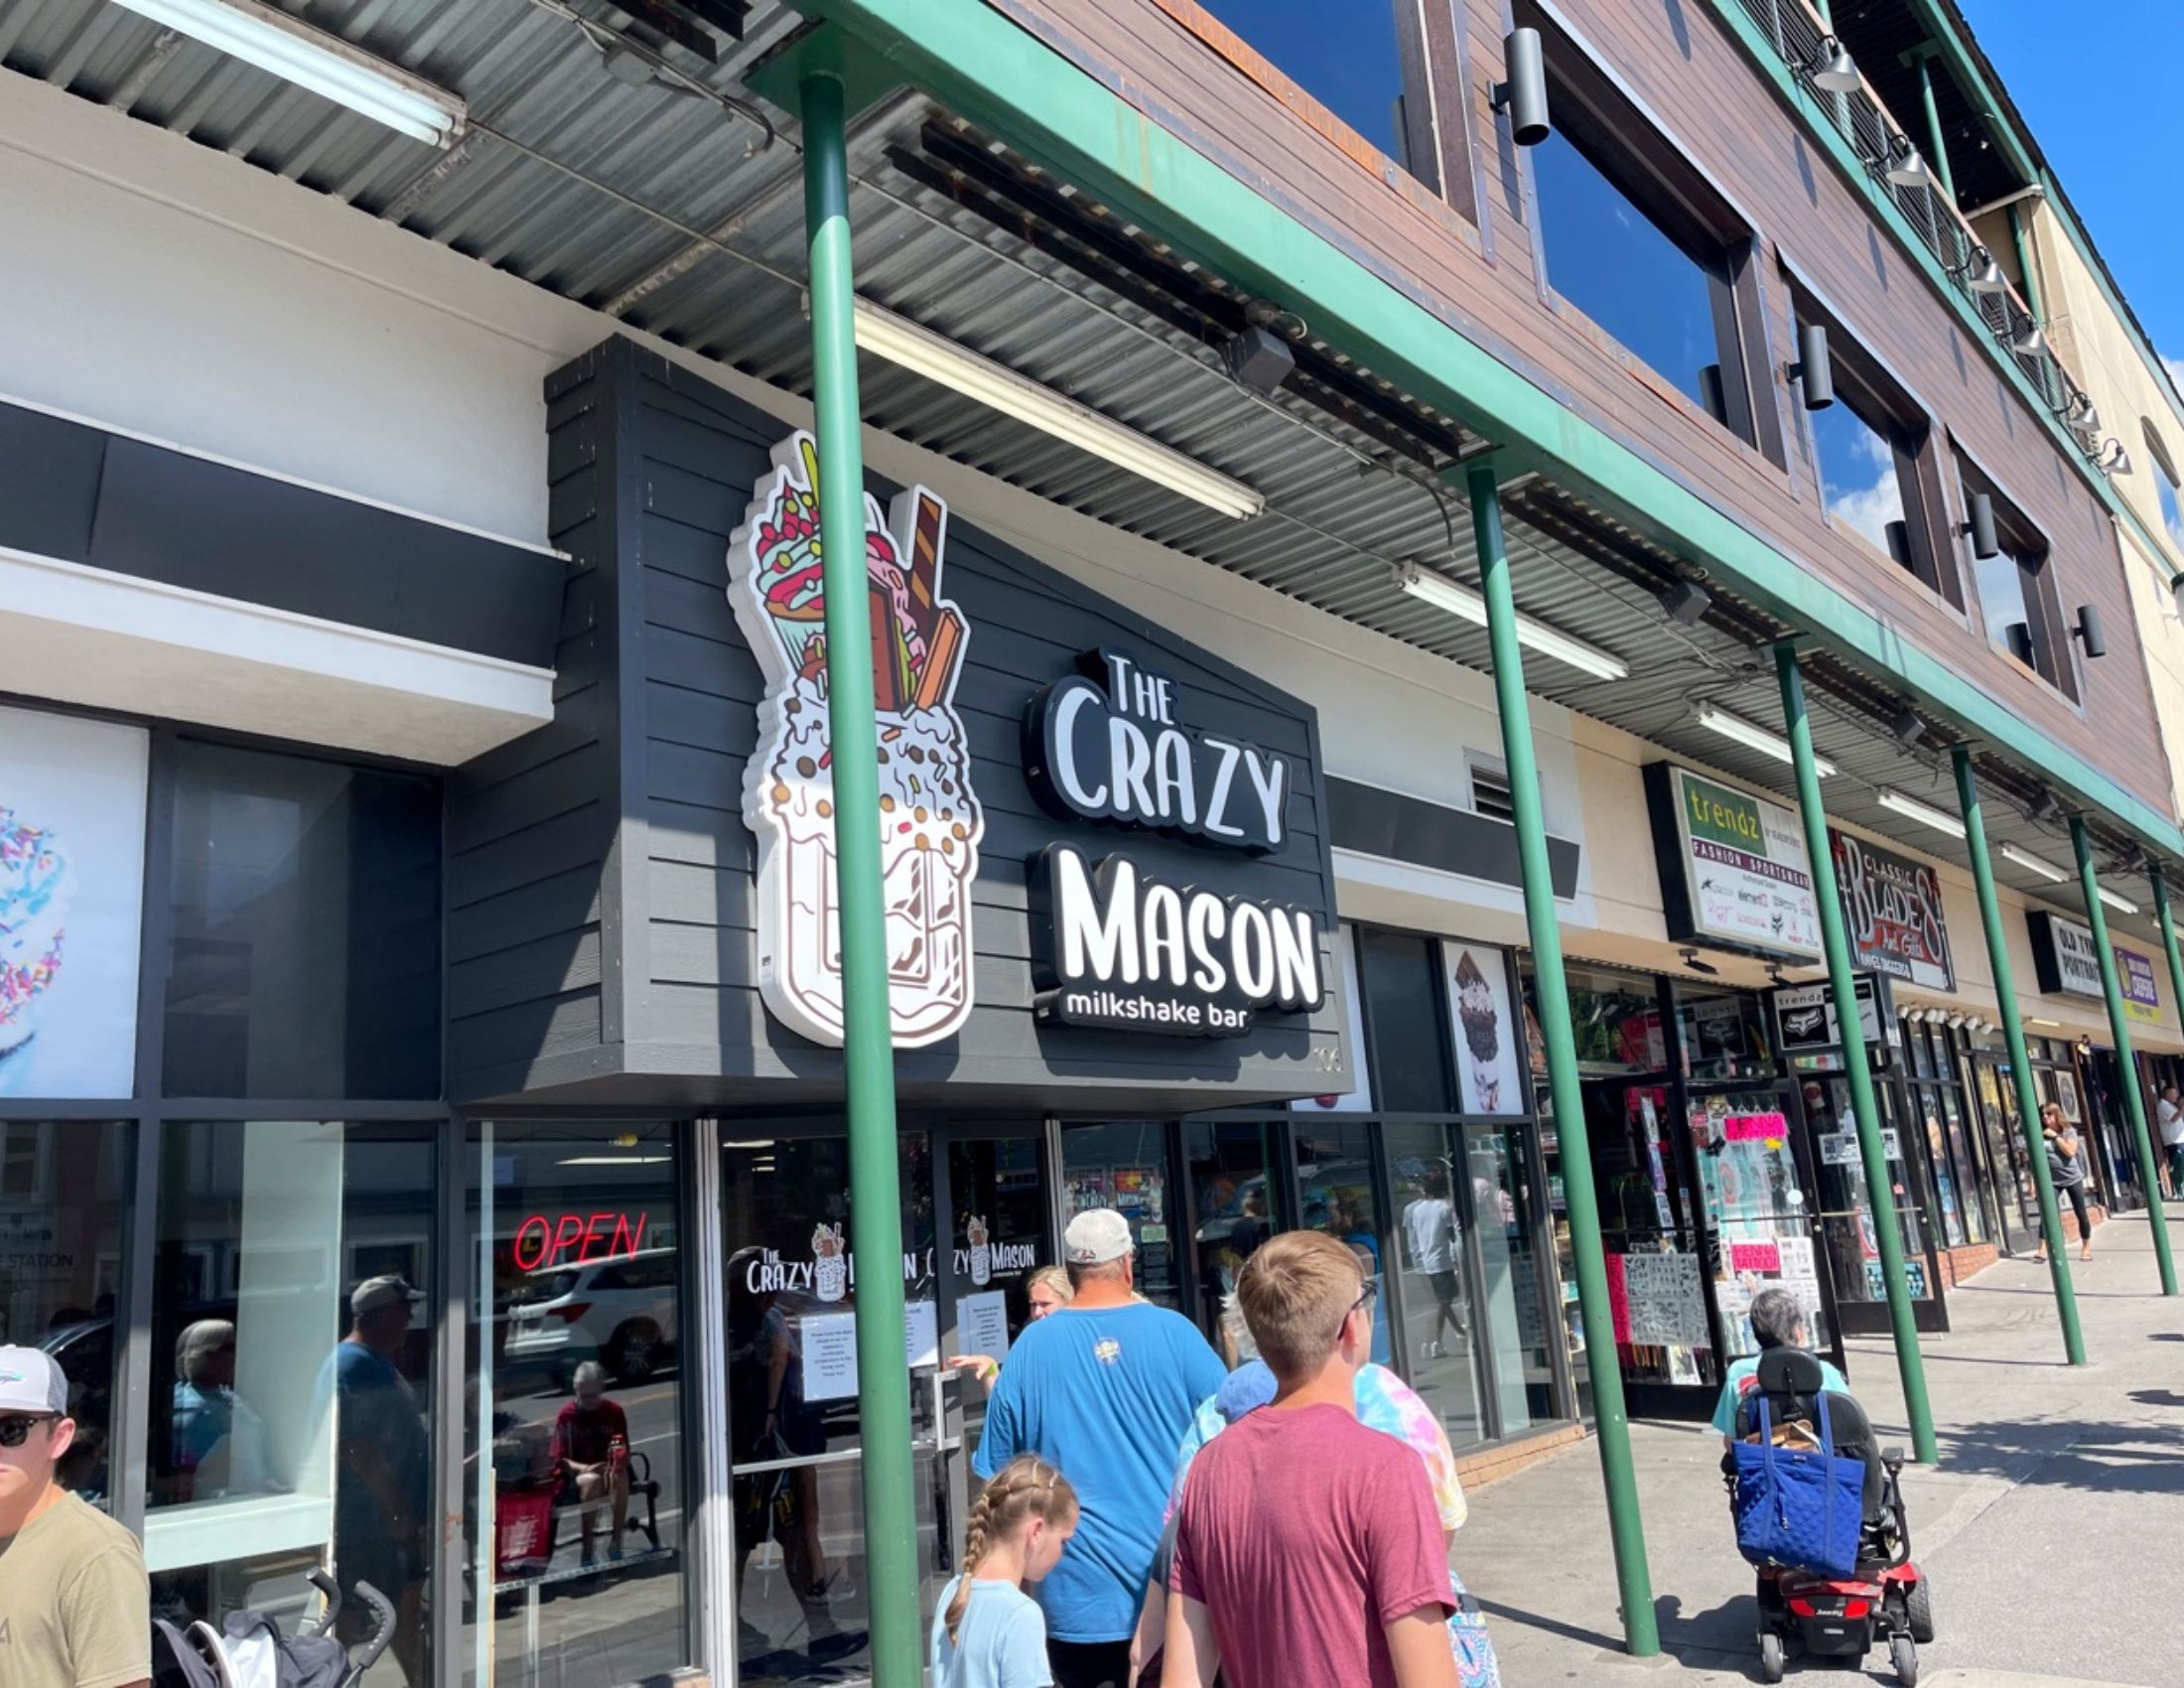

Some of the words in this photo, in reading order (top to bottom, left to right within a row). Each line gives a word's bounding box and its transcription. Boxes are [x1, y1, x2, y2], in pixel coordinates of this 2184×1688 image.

[1109, 654, 1174, 726] THE
[1054, 685, 1285, 844] CRAZY
[1691, 788, 1760, 840] trendz
[1693, 840, 1742, 867] FASHION
[1750, 858, 1810, 890] SPORTSWEAR
[1863, 854, 1914, 887] CLASSIC
[1841, 836, 1943, 965] BLADES
[1058, 849, 1318, 1005] MASON
[1066, 992, 1201, 1025] milkshake
[1209, 1002, 1249, 1029] bar
[1778, 993, 1822, 1005] trendz
[8, 1253, 73, 1268] STATION
[513, 1211, 646, 1270] OPEN
[763, 1247, 779, 1264] THE
[991, 1241, 1035, 1271] MASON
[747, 1260, 814, 1293] CRAZY
